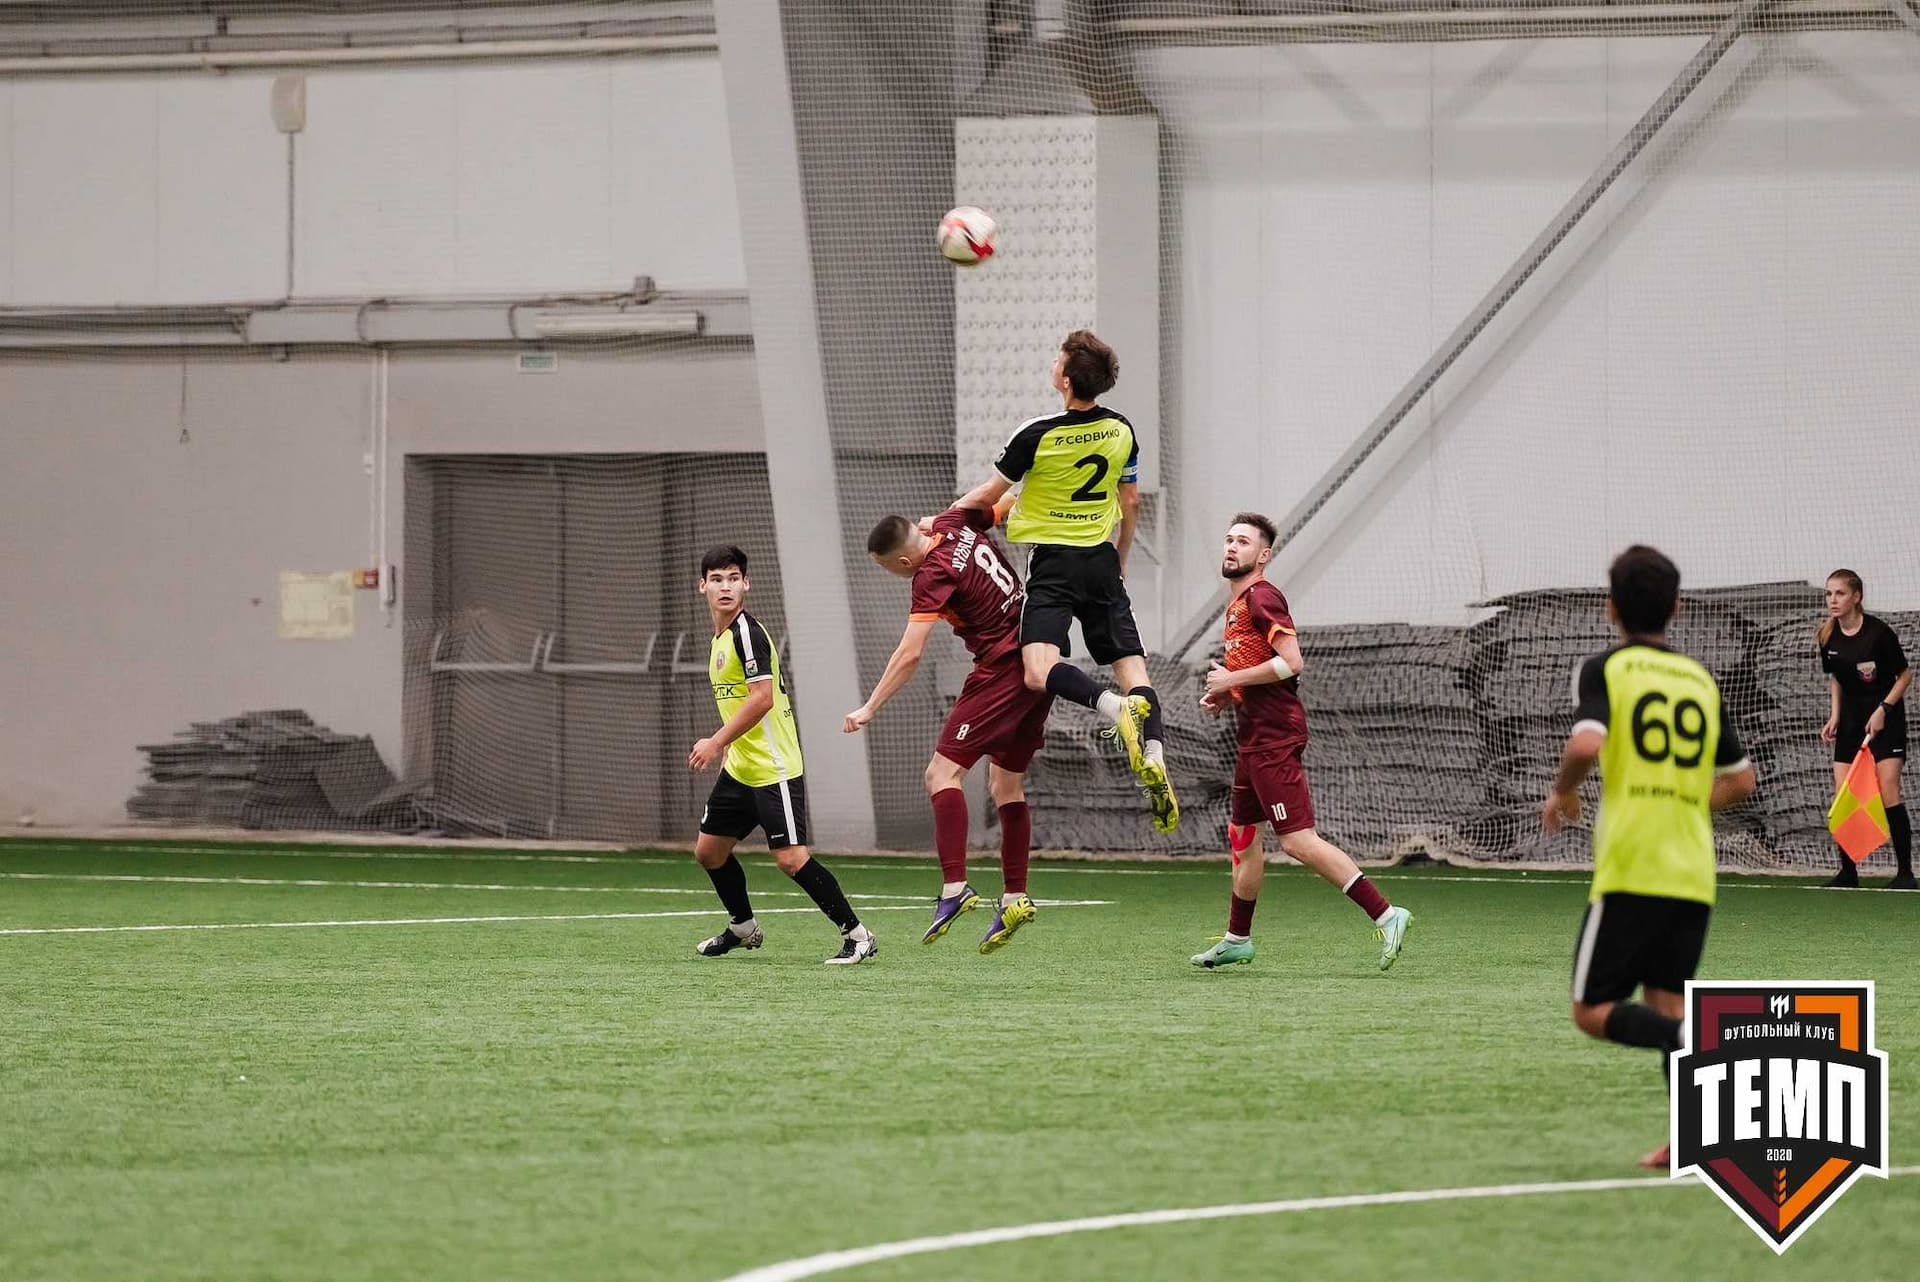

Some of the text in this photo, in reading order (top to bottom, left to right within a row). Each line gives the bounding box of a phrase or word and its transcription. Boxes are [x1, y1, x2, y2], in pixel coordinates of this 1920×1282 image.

[1070, 453, 1109, 502] 2
[974, 543, 1015, 597] 8
[956, 723, 971, 740] 8
[1631, 691, 1707, 769] 69
[1271, 802, 1288, 822] 10
